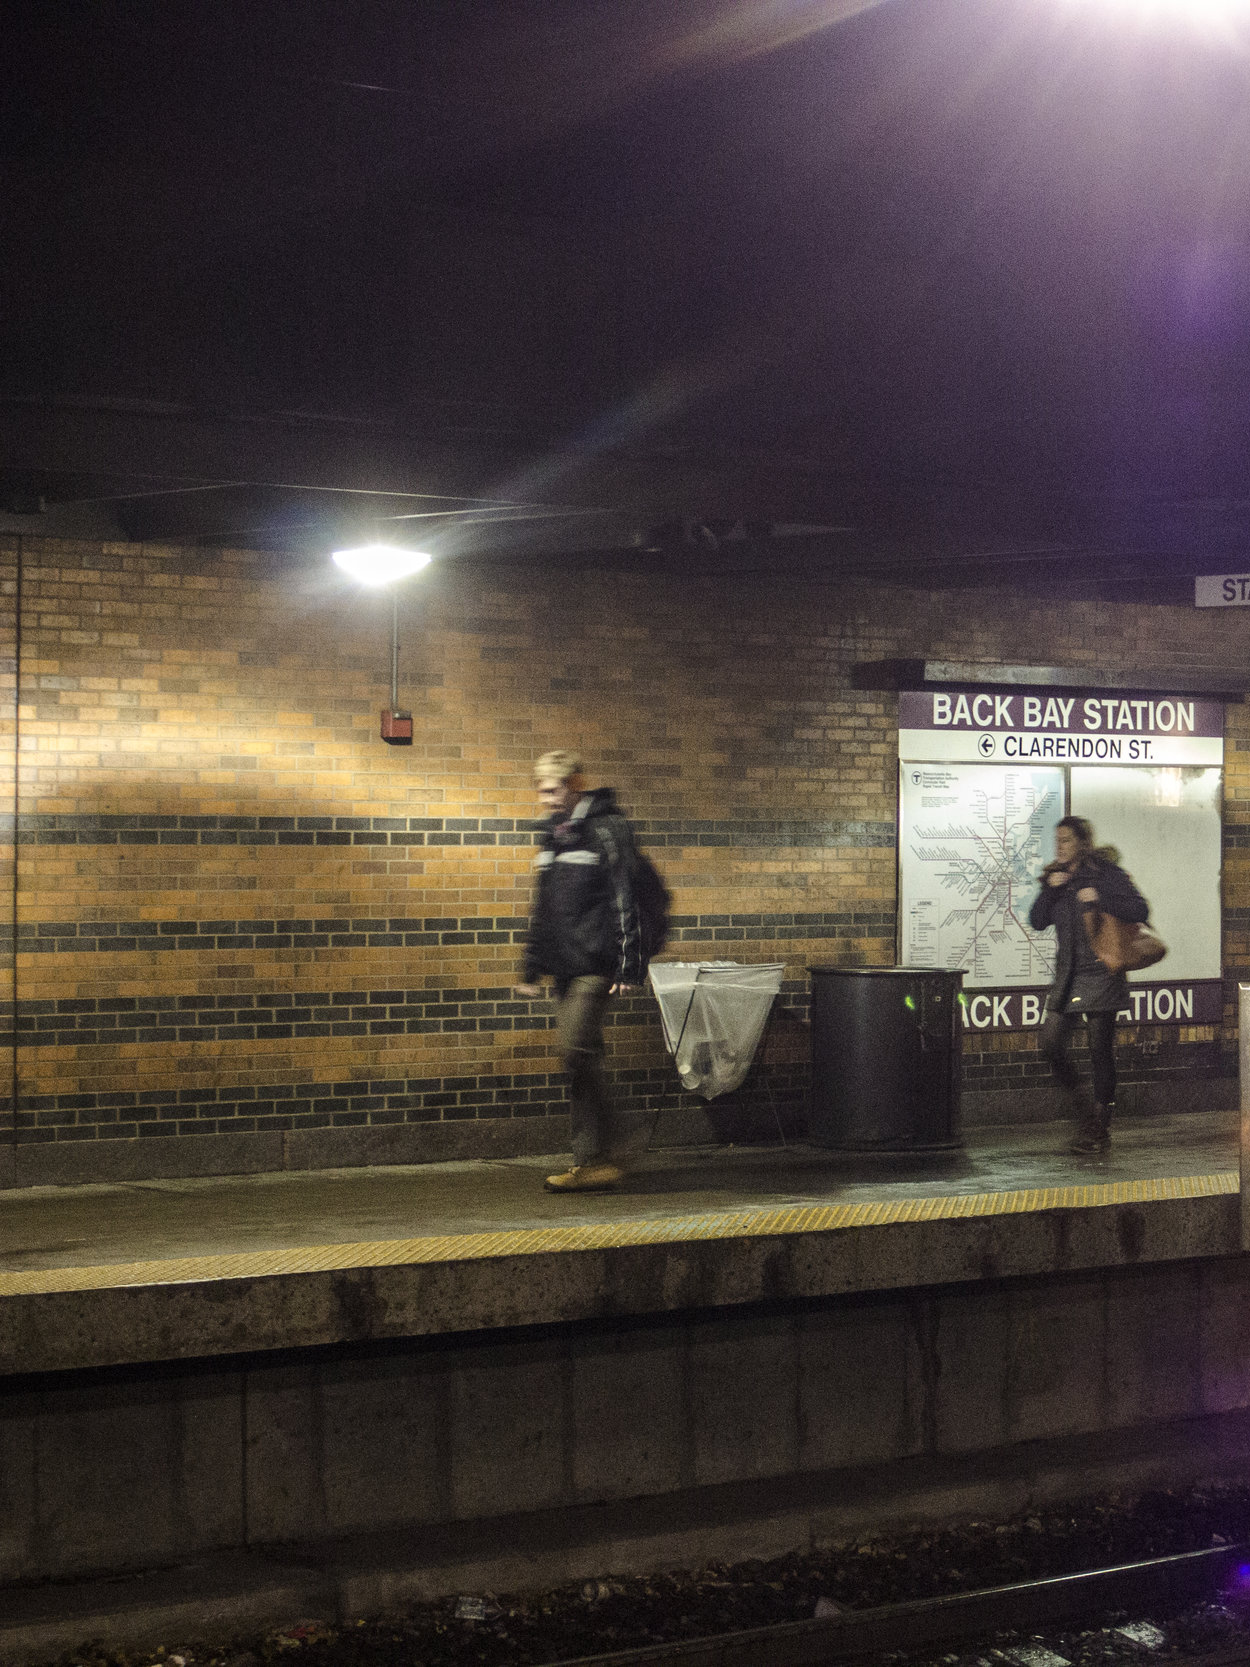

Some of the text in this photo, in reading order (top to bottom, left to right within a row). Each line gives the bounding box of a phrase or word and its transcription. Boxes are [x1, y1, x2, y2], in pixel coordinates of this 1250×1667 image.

[933, 693, 1194, 731] BACK BAY STATION
[1004, 735, 1153, 759] CLARENDON ST.
[1115, 988, 1193, 1021] TION
